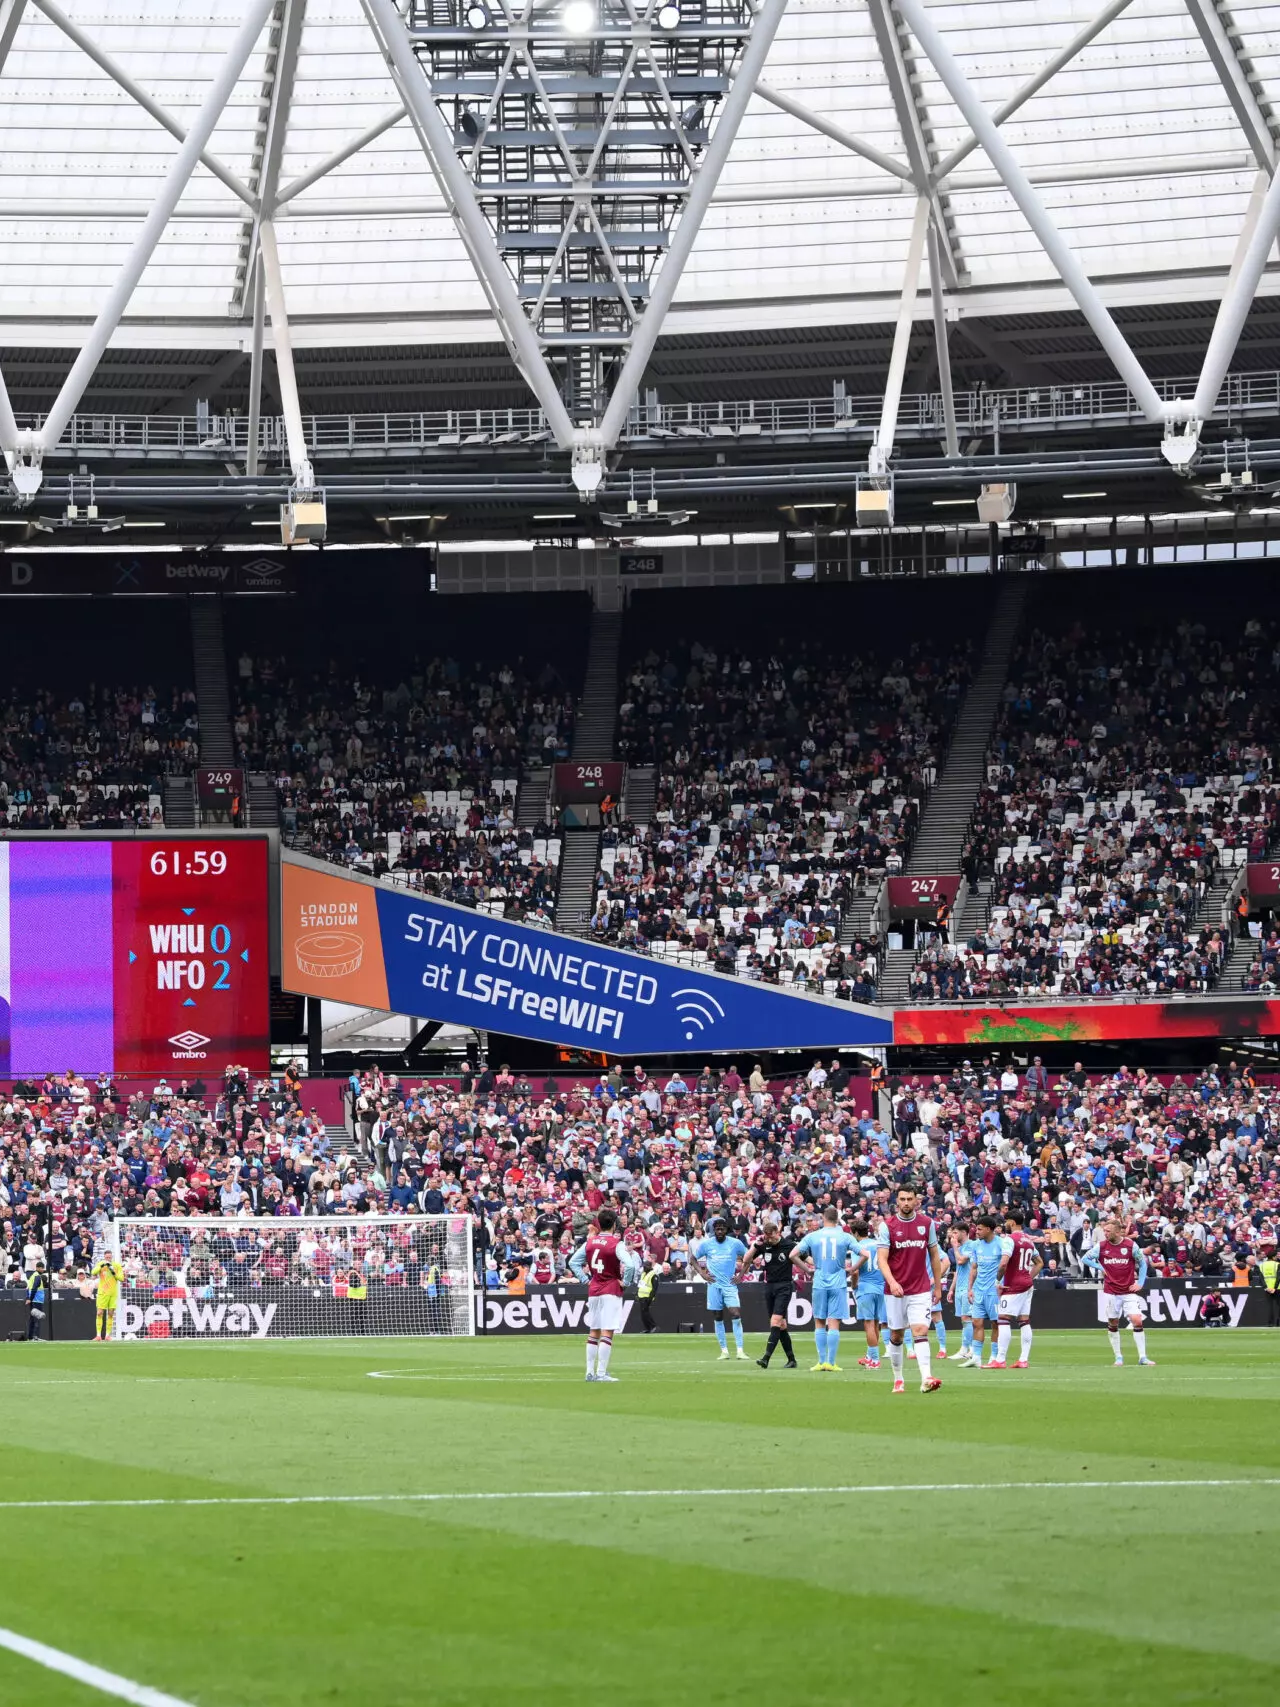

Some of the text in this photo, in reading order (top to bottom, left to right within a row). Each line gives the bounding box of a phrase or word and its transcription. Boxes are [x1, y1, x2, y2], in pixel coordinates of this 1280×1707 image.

[165, 564, 230, 582] betway
[245, 576, 282, 586] umbro
[207, 772, 232, 785] 249
[577, 766, 602, 779] 248
[150, 850, 228, 876] 61:59
[911, 879, 938, 893] 247
[300, 903, 358, 915] LONDON
[300, 915, 358, 927] STADIUM
[149, 923, 232, 954] WHU 0
[404, 913, 658, 1006] STAY CONNECTED
[157, 959, 231, 990] NFO 2
[422, 963, 624, 1039] at LSFreeWIFI
[172, 1049, 207, 1059] umbro
[820, 1238, 837, 1260] 11
[895, 1239, 926, 1249] betway
[591, 1249, 605, 1274] 4
[1018, 1247, 1034, 1274] 10
[1103, 1257, 1130, 1265] betway
